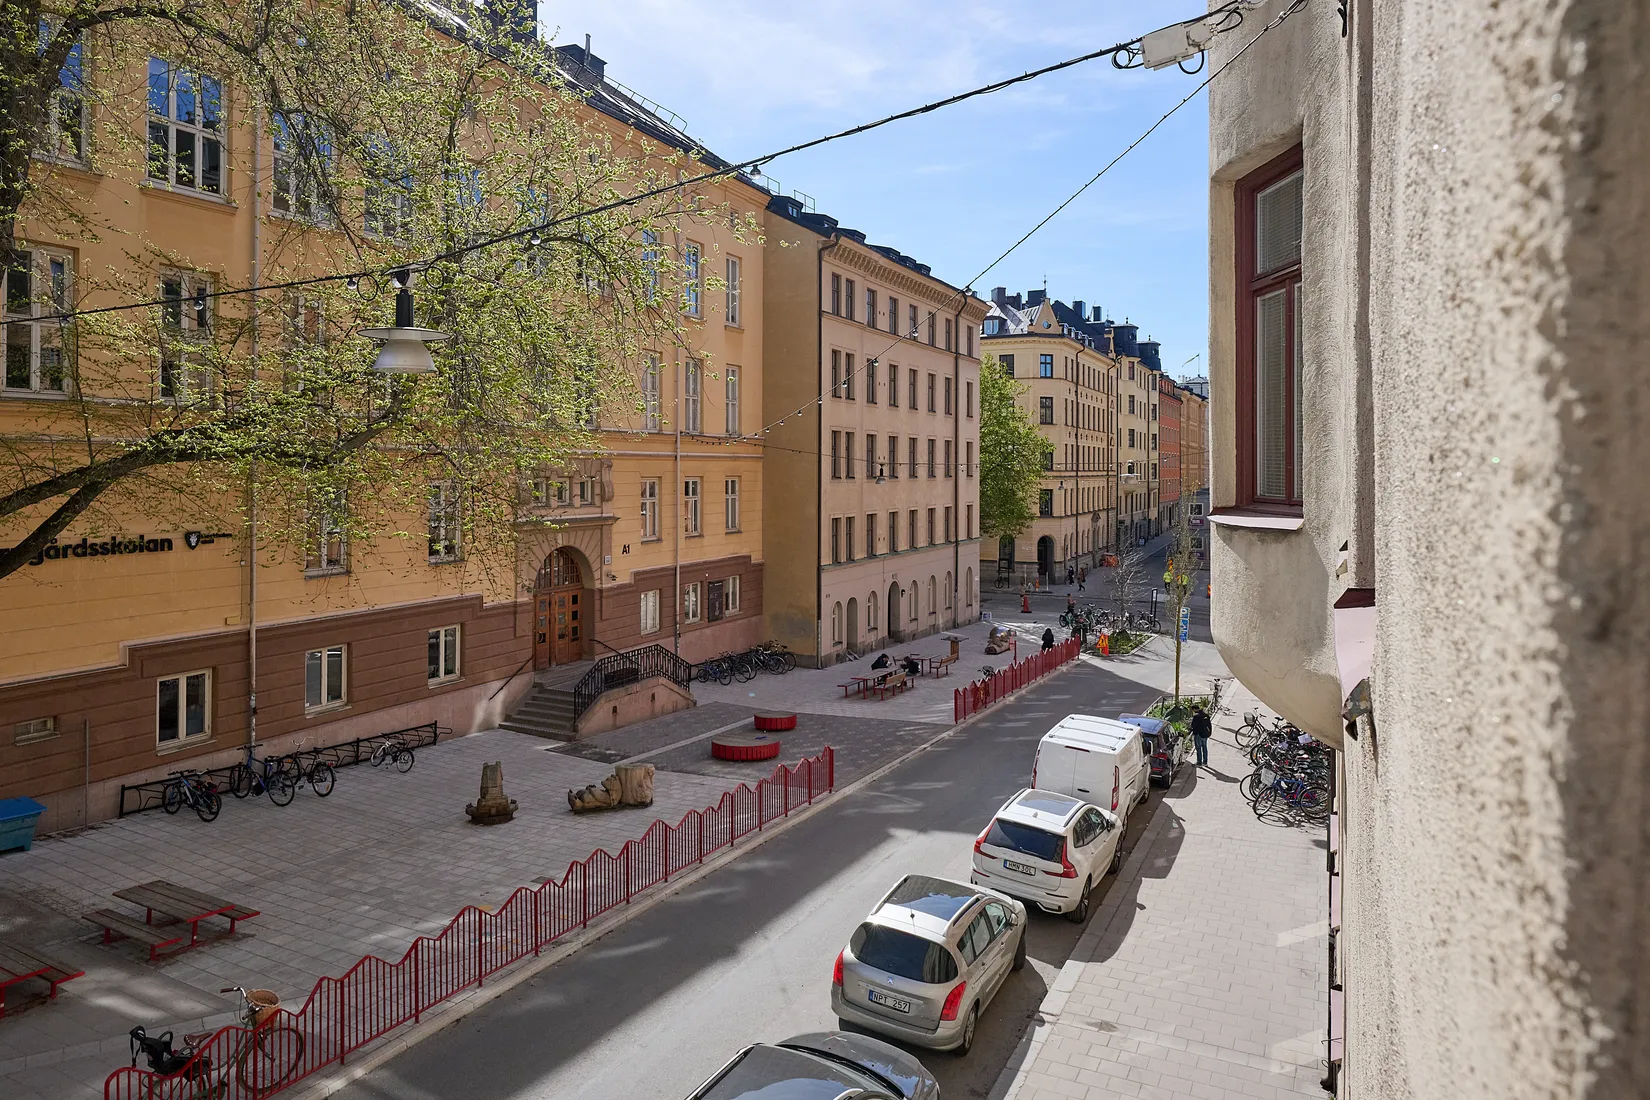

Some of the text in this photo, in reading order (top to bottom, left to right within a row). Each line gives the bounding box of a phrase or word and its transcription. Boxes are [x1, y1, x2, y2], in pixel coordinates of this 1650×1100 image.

[622, 543, 631, 555] A1
[873, 992, 908, 1010] NPT 257
